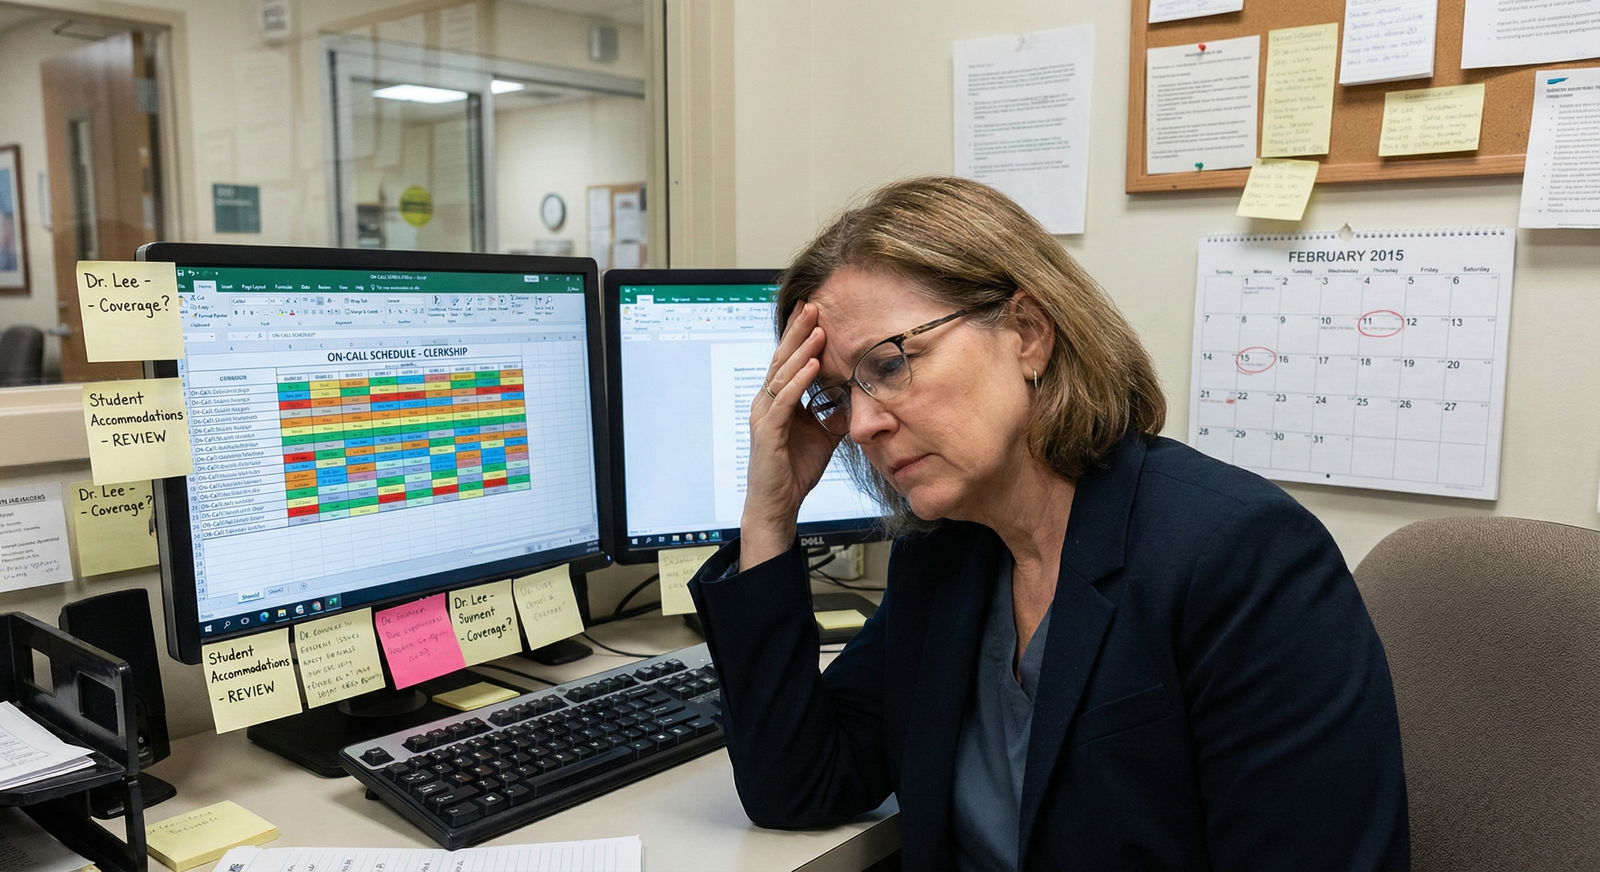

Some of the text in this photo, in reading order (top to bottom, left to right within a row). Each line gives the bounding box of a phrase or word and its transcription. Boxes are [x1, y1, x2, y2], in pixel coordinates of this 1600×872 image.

[1289, 250, 1403, 262] FEBRUARY 2015
[1420, 266, 1440, 275] Friday
[84, 272, 108, 289] Dr.
[112, 272, 140, 288] Lee
[1244, 275, 1460, 286] 1 2 3 4 5 6
[99, 294, 170, 319] Coverage?
[1204, 315, 1464, 328] 7 8 9 10 11 12 13
[327, 351, 369, 362] ON-CALL
[370, 349, 416, 361] SCHEDULE
[423, 347, 468, 358] CLERKSHIP
[1202, 352, 1460, 370] 14 15 16 17 18 19 20
[89, 391, 145, 408] Student
[1200, 389, 1457, 412] 21 22 23 24 25 26 27
[90, 409, 184, 427] Accommodations
[112, 430, 167, 447] REVIEW
[1198, 426, 1324, 444] 28 29 30 31
[79, 487, 98, 502] Dr.
[102, 484, 125, 498] Lee
[91, 495, 153, 518] Coverage?
[801, 536, 825, 546] DELL
[454, 596, 469, 610] Dr.
[471, 593, 487, 606] Lee
[466, 616, 514, 642] Coverage?
[208, 645, 255, 666] Student
[211, 658, 290, 684] Accommodations
[227, 680, 276, 704] REVIEW
